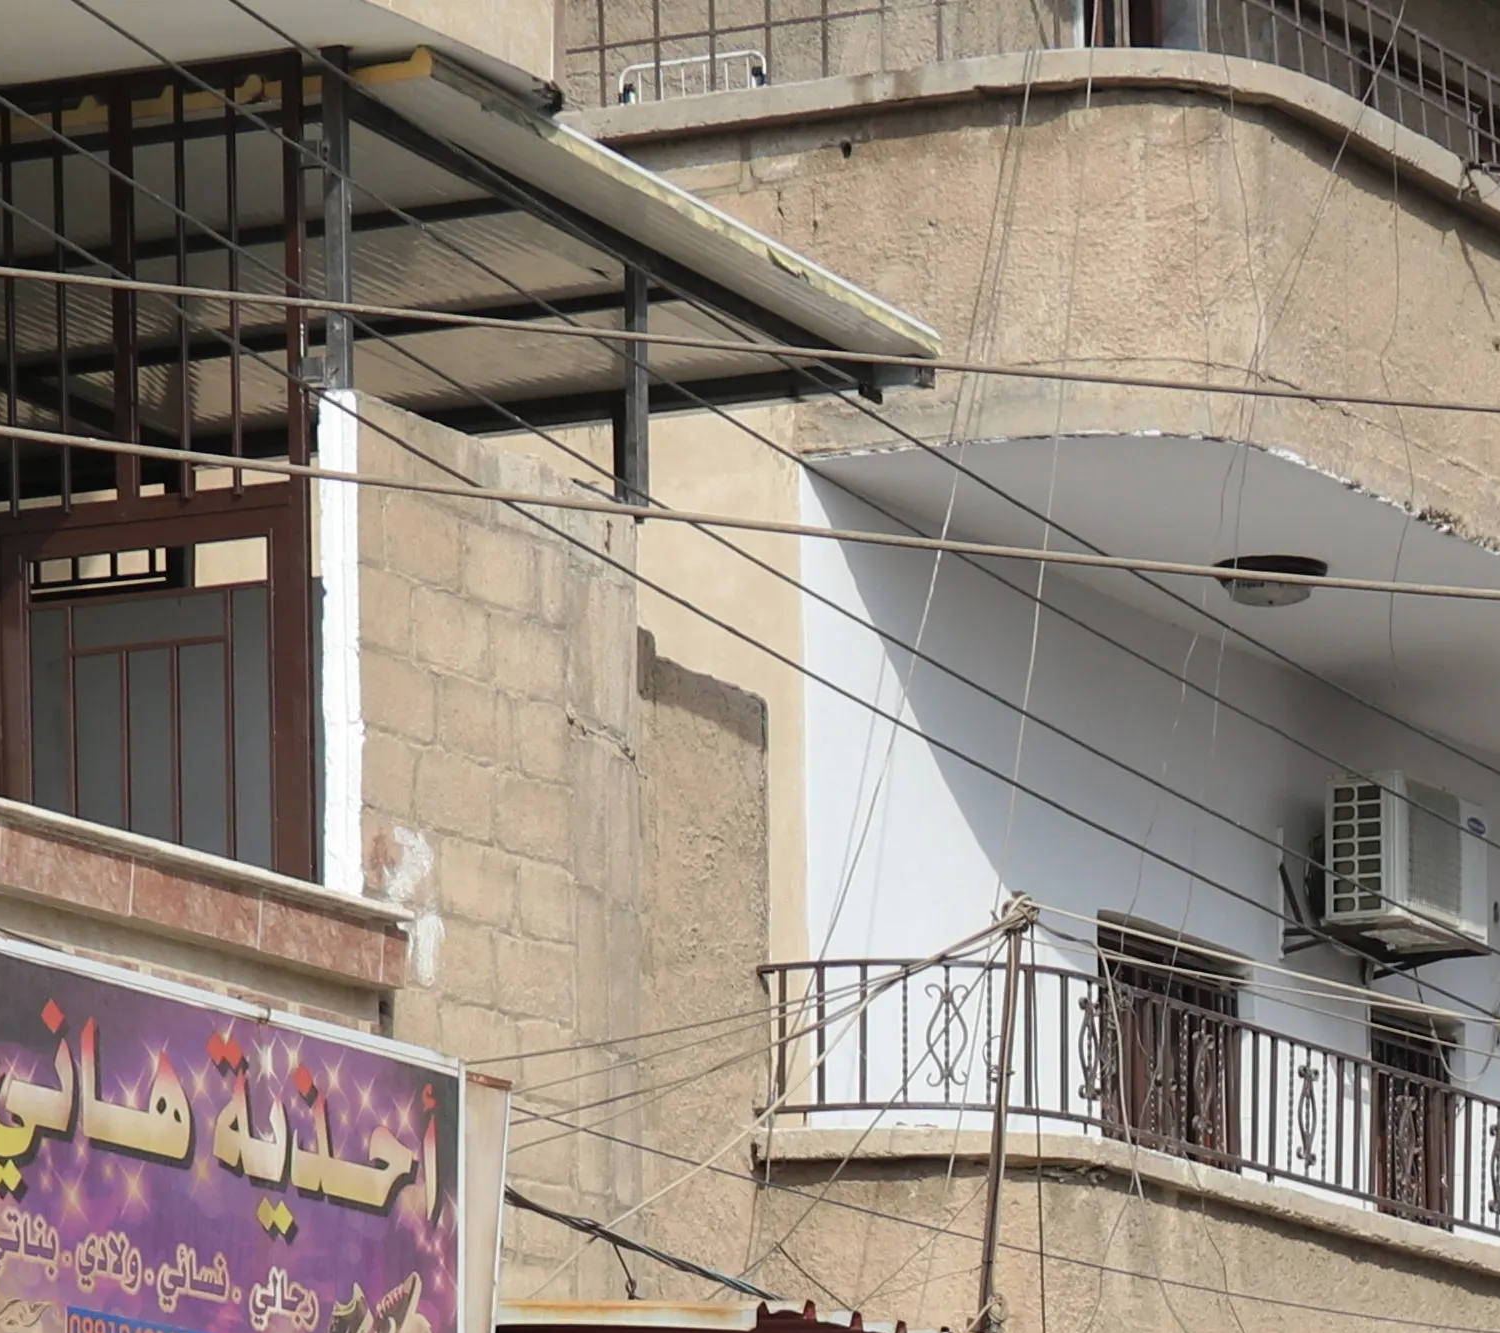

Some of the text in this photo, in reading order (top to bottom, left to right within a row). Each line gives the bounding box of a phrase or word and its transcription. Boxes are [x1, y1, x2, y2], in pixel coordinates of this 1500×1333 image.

[207, 1032, 438, 1237] أحذية
[76, 1232, 141, 1294] ولادي
[158, 1243, 229, 1312] نسائي
[251, 1266, 319, 1330] رجالي
